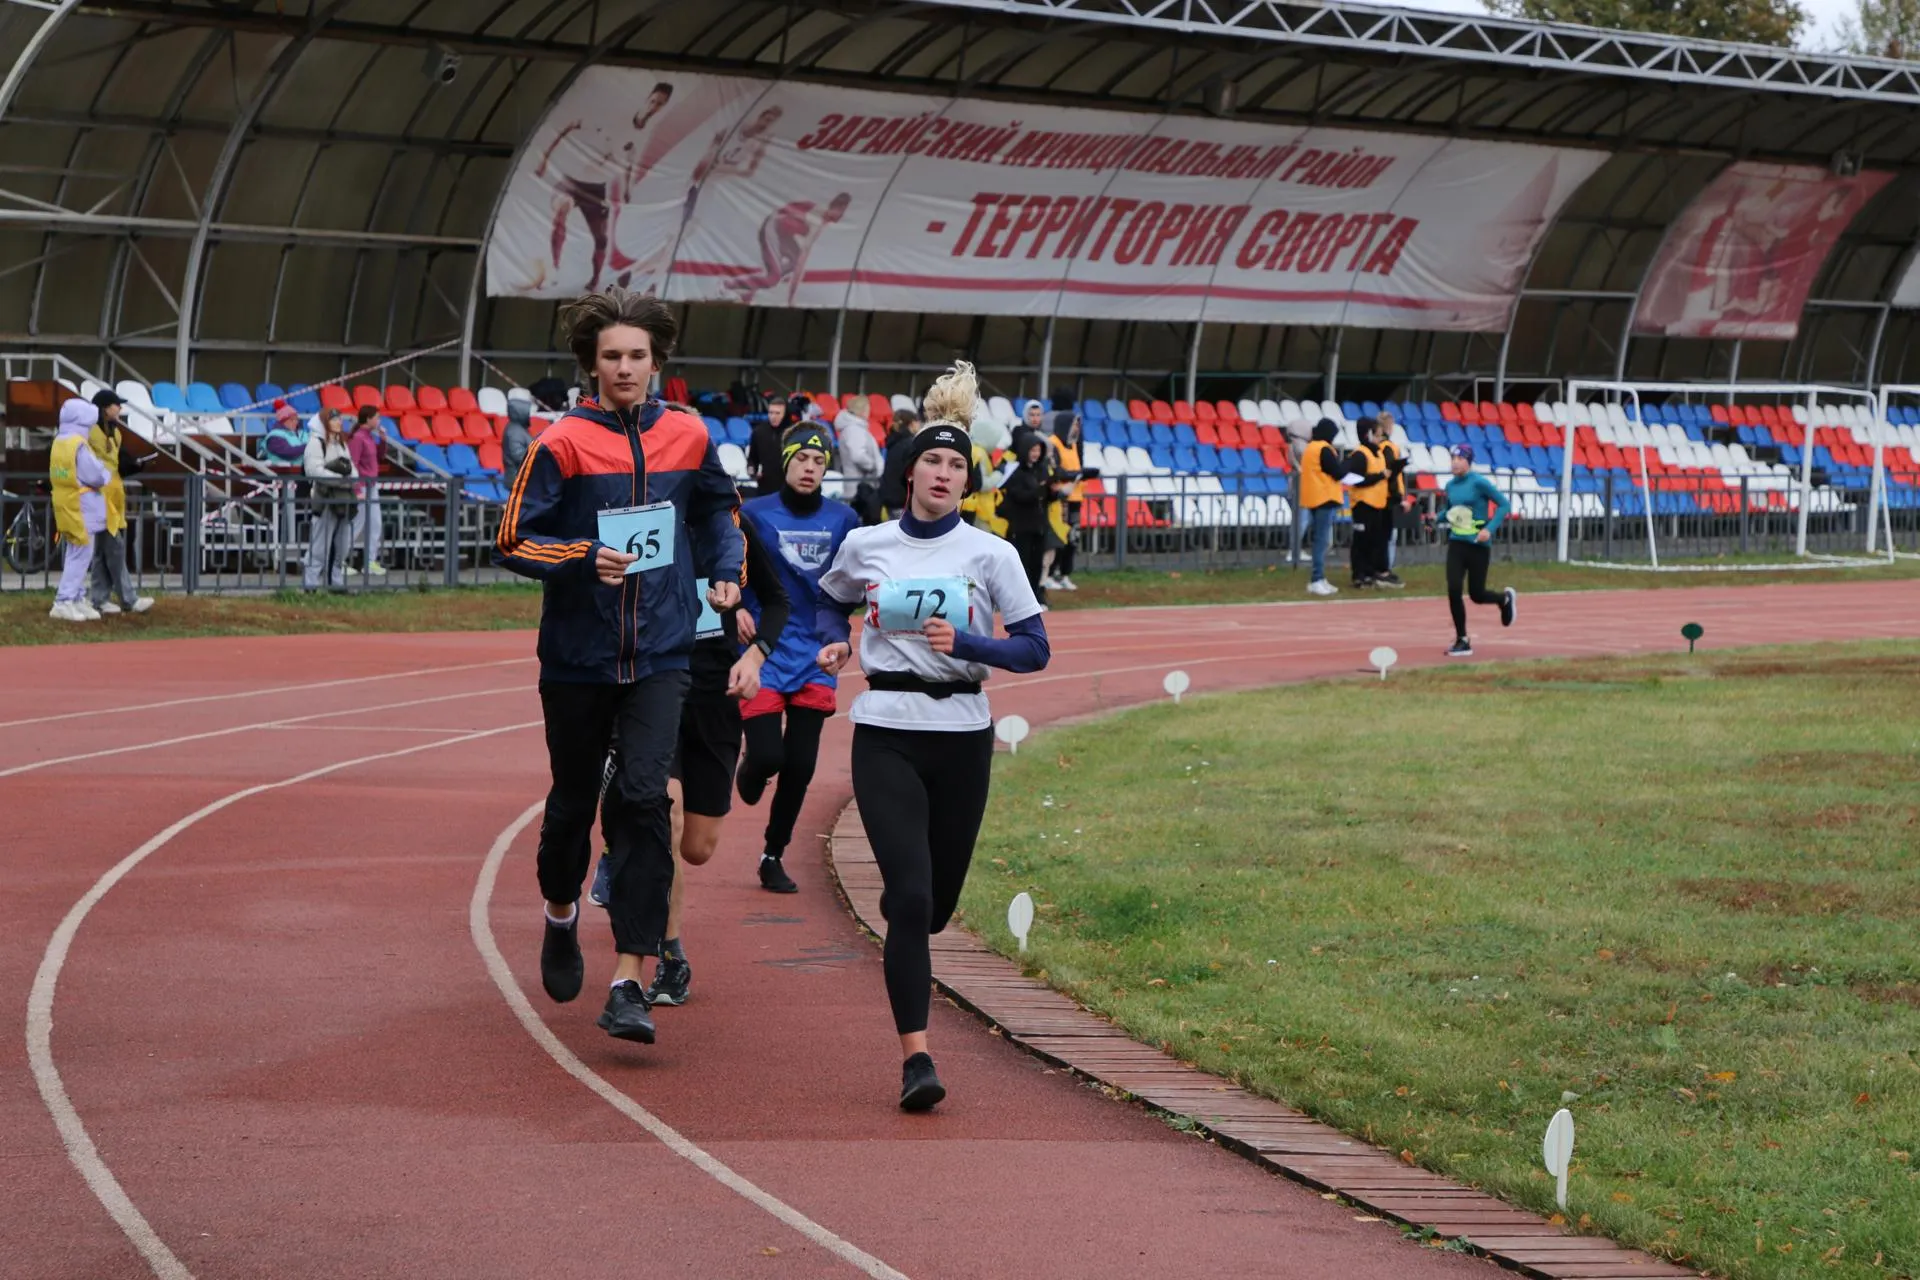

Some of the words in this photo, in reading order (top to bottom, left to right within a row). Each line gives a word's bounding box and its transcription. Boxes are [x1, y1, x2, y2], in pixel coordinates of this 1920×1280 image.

[797, 111, 1023, 163] ЗАРАЙСКИЙ
[1000, 130, 1303, 179] МУНИЦИПАЛЬНЫЙ
[1279, 145, 1396, 189] РАЙОН
[951, 192, 1252, 267] ТЕРРИТОРИЯ
[1235, 208, 1420, 276] СПОРТА
[626, 528, 660, 560] 65
[905, 589, 947, 620] 72
